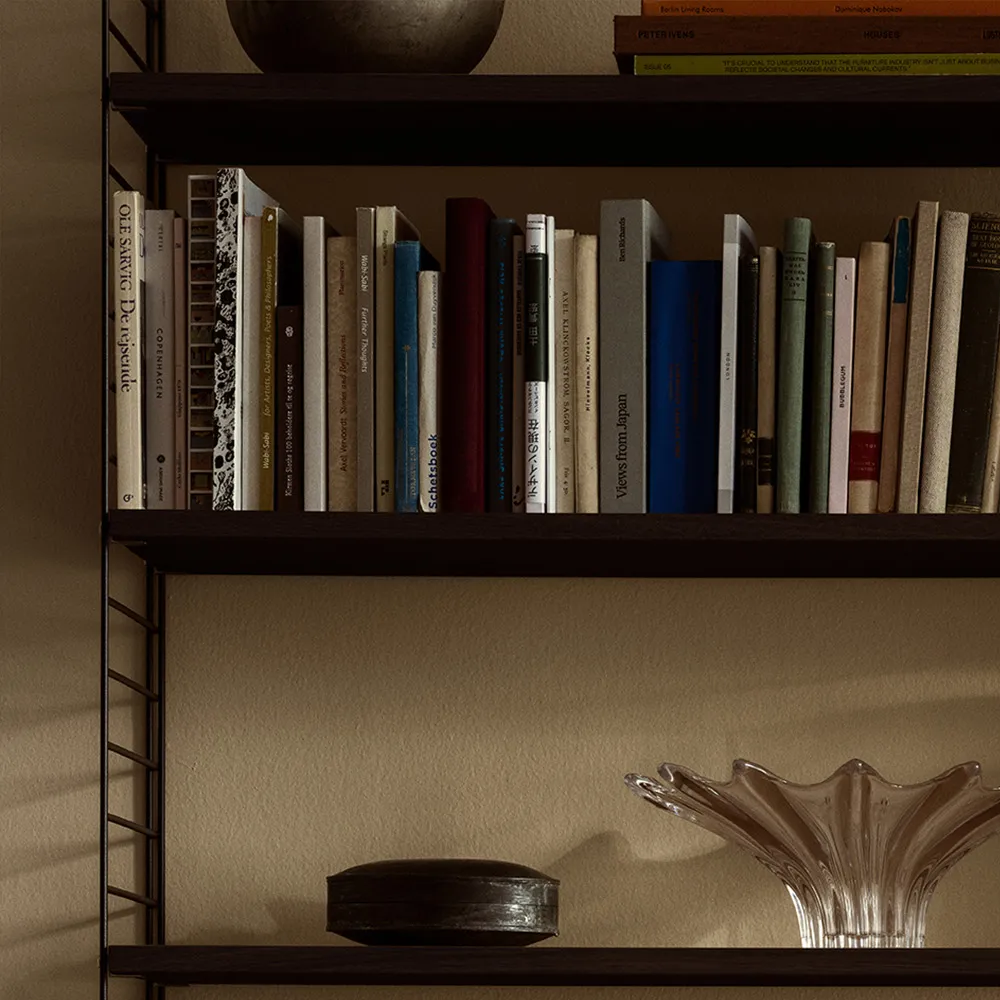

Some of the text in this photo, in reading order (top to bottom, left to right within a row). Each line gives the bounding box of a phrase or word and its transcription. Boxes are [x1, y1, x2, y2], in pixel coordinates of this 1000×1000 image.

[702, 6, 724, 14] Rooms
[864, 31, 900, 39] HOUSES
[618, 217, 626, 262] Ben Richards
[118, 204, 137, 393] OLE SARVIG De rejsende
[360, 255, 369, 372] Wabi-Sabi Further Thoughts
[156, 328, 164, 399] COPENHAGEN
[340, 375, 348, 390] and
[428, 434, 438, 509] Schetsboek
[616, 394, 630, 499] Views from Japan
